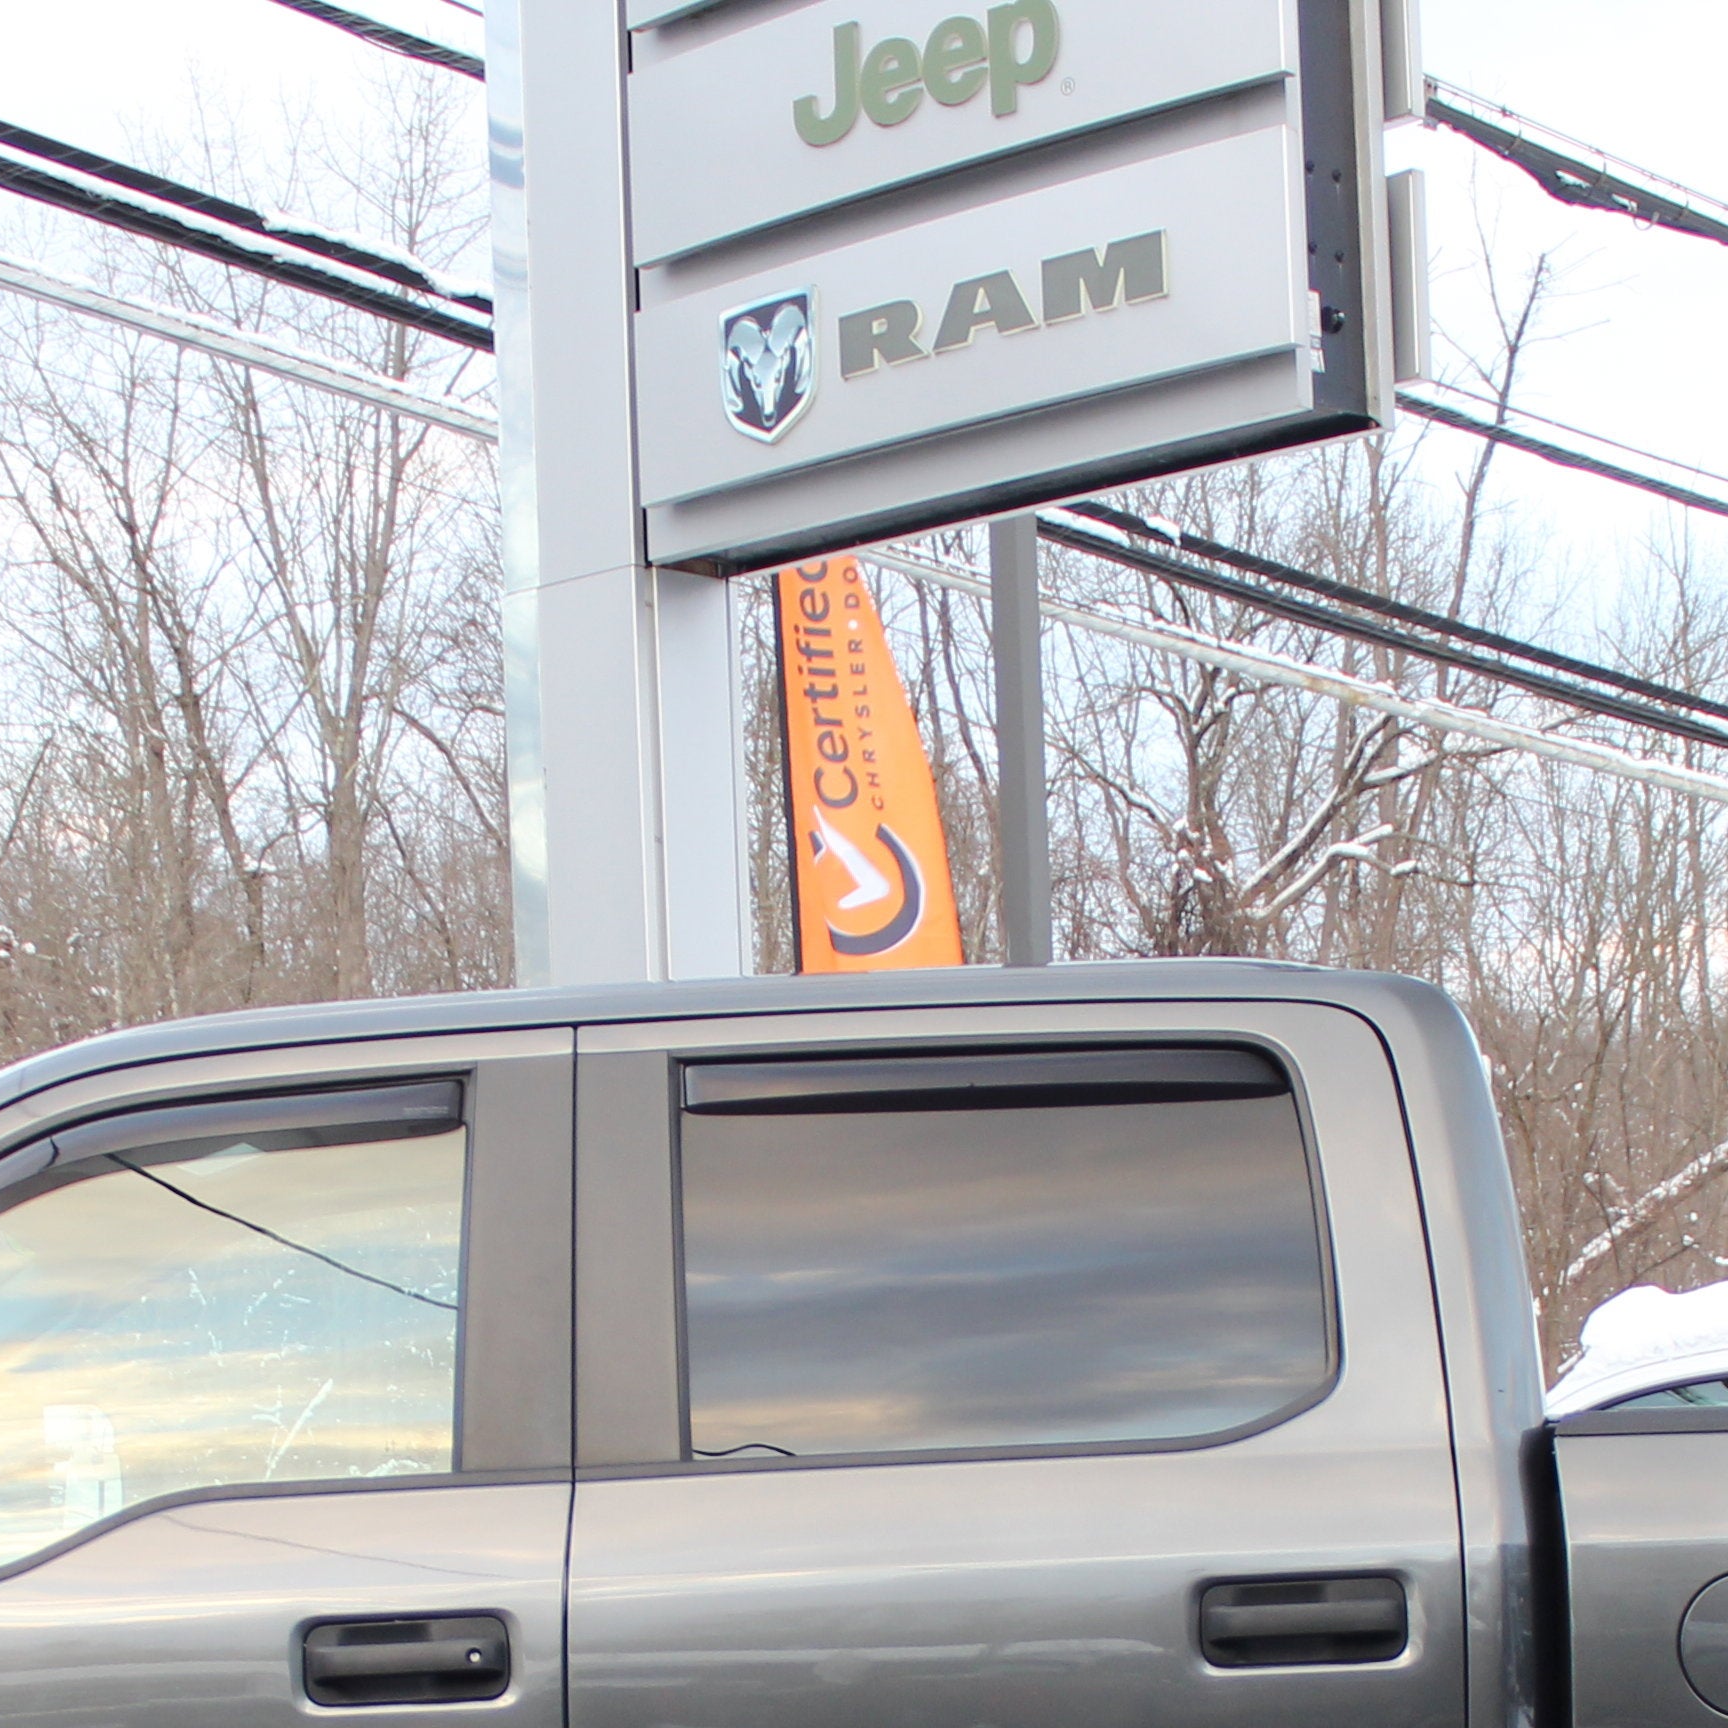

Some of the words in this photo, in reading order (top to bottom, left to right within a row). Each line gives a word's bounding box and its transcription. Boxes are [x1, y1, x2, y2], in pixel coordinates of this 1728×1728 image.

[792, 0, 1060, 148] Jeep
[837, 228, 1169, 381] RAM
[847, 638, 885, 811] CHRYSLER
